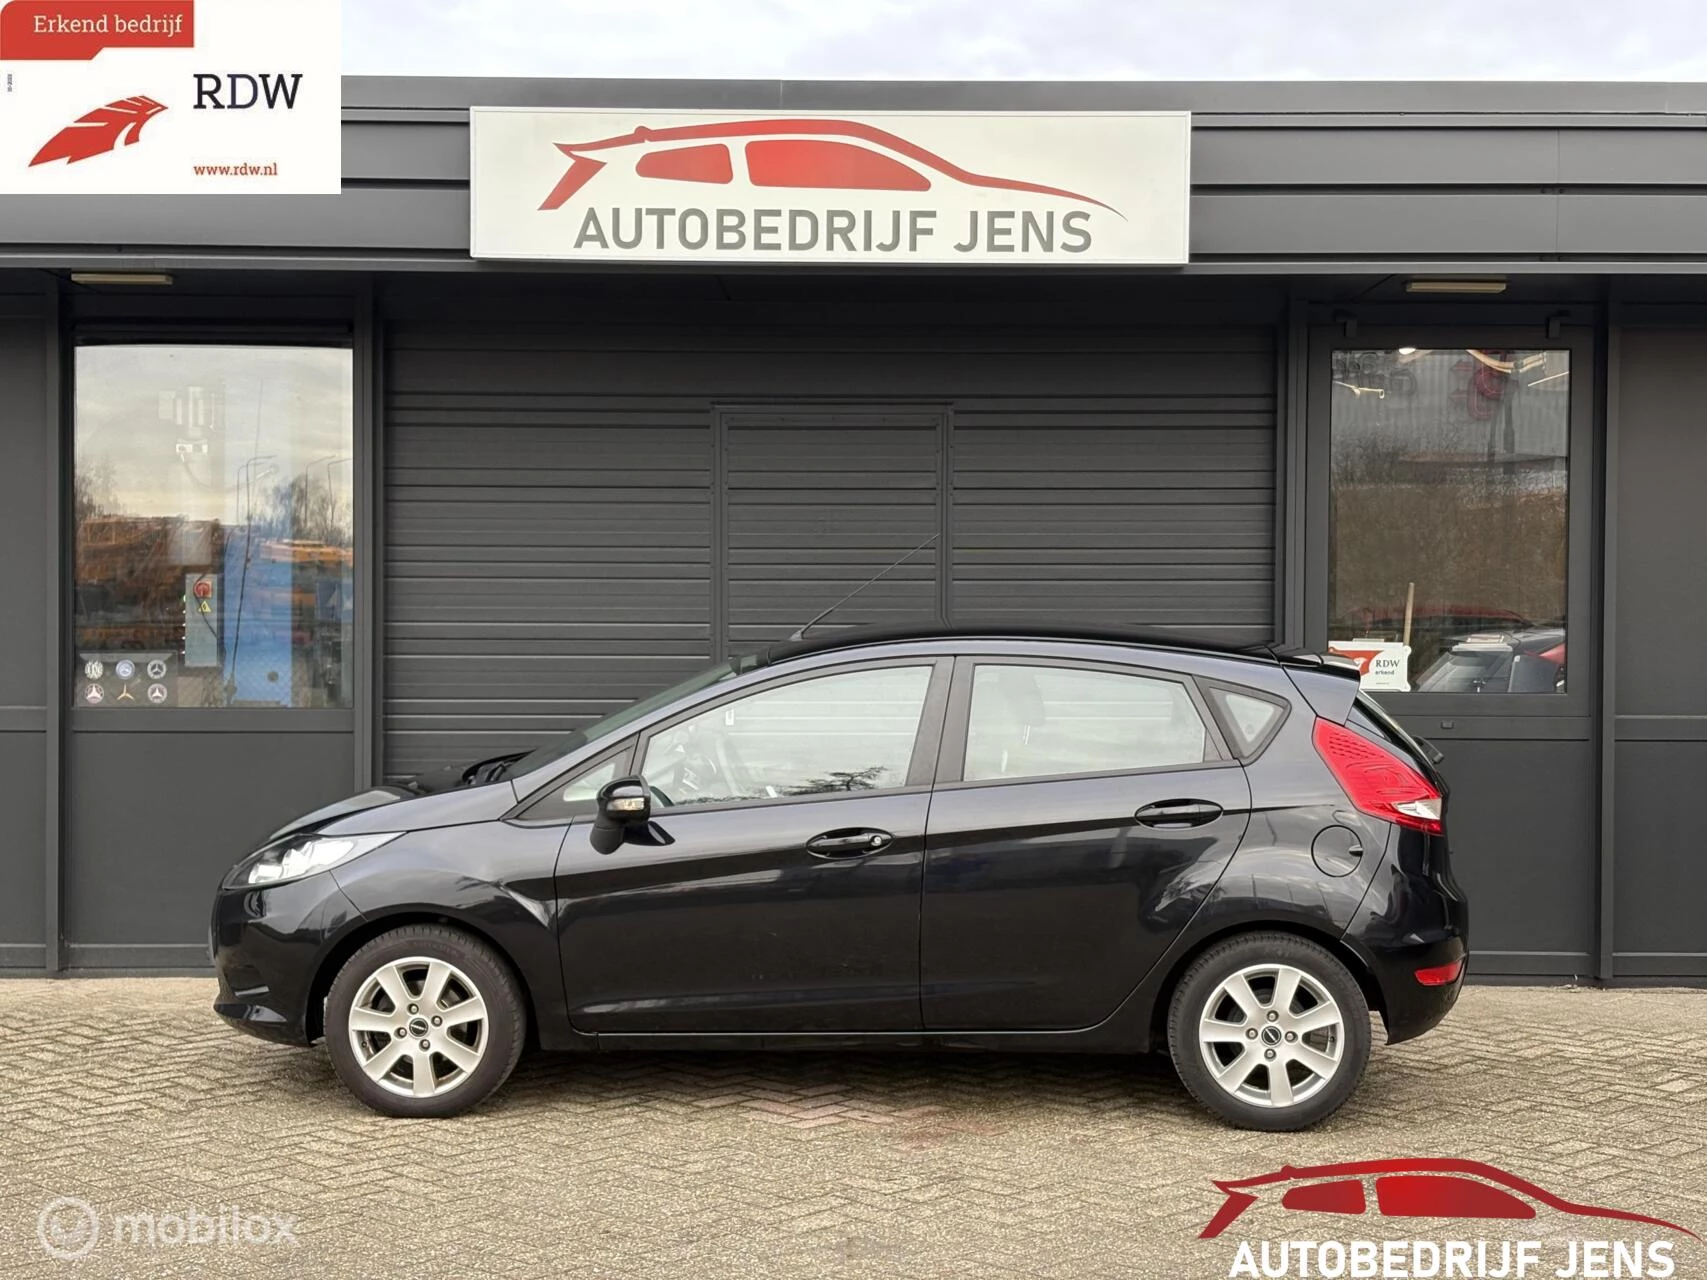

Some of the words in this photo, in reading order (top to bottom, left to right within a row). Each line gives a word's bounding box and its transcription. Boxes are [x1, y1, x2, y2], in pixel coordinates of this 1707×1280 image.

[573, 206, 937, 252] AUTOBEDRIJF
[953, 210, 1092, 253] JENS
[1375, 659, 1400, 668] RDW
